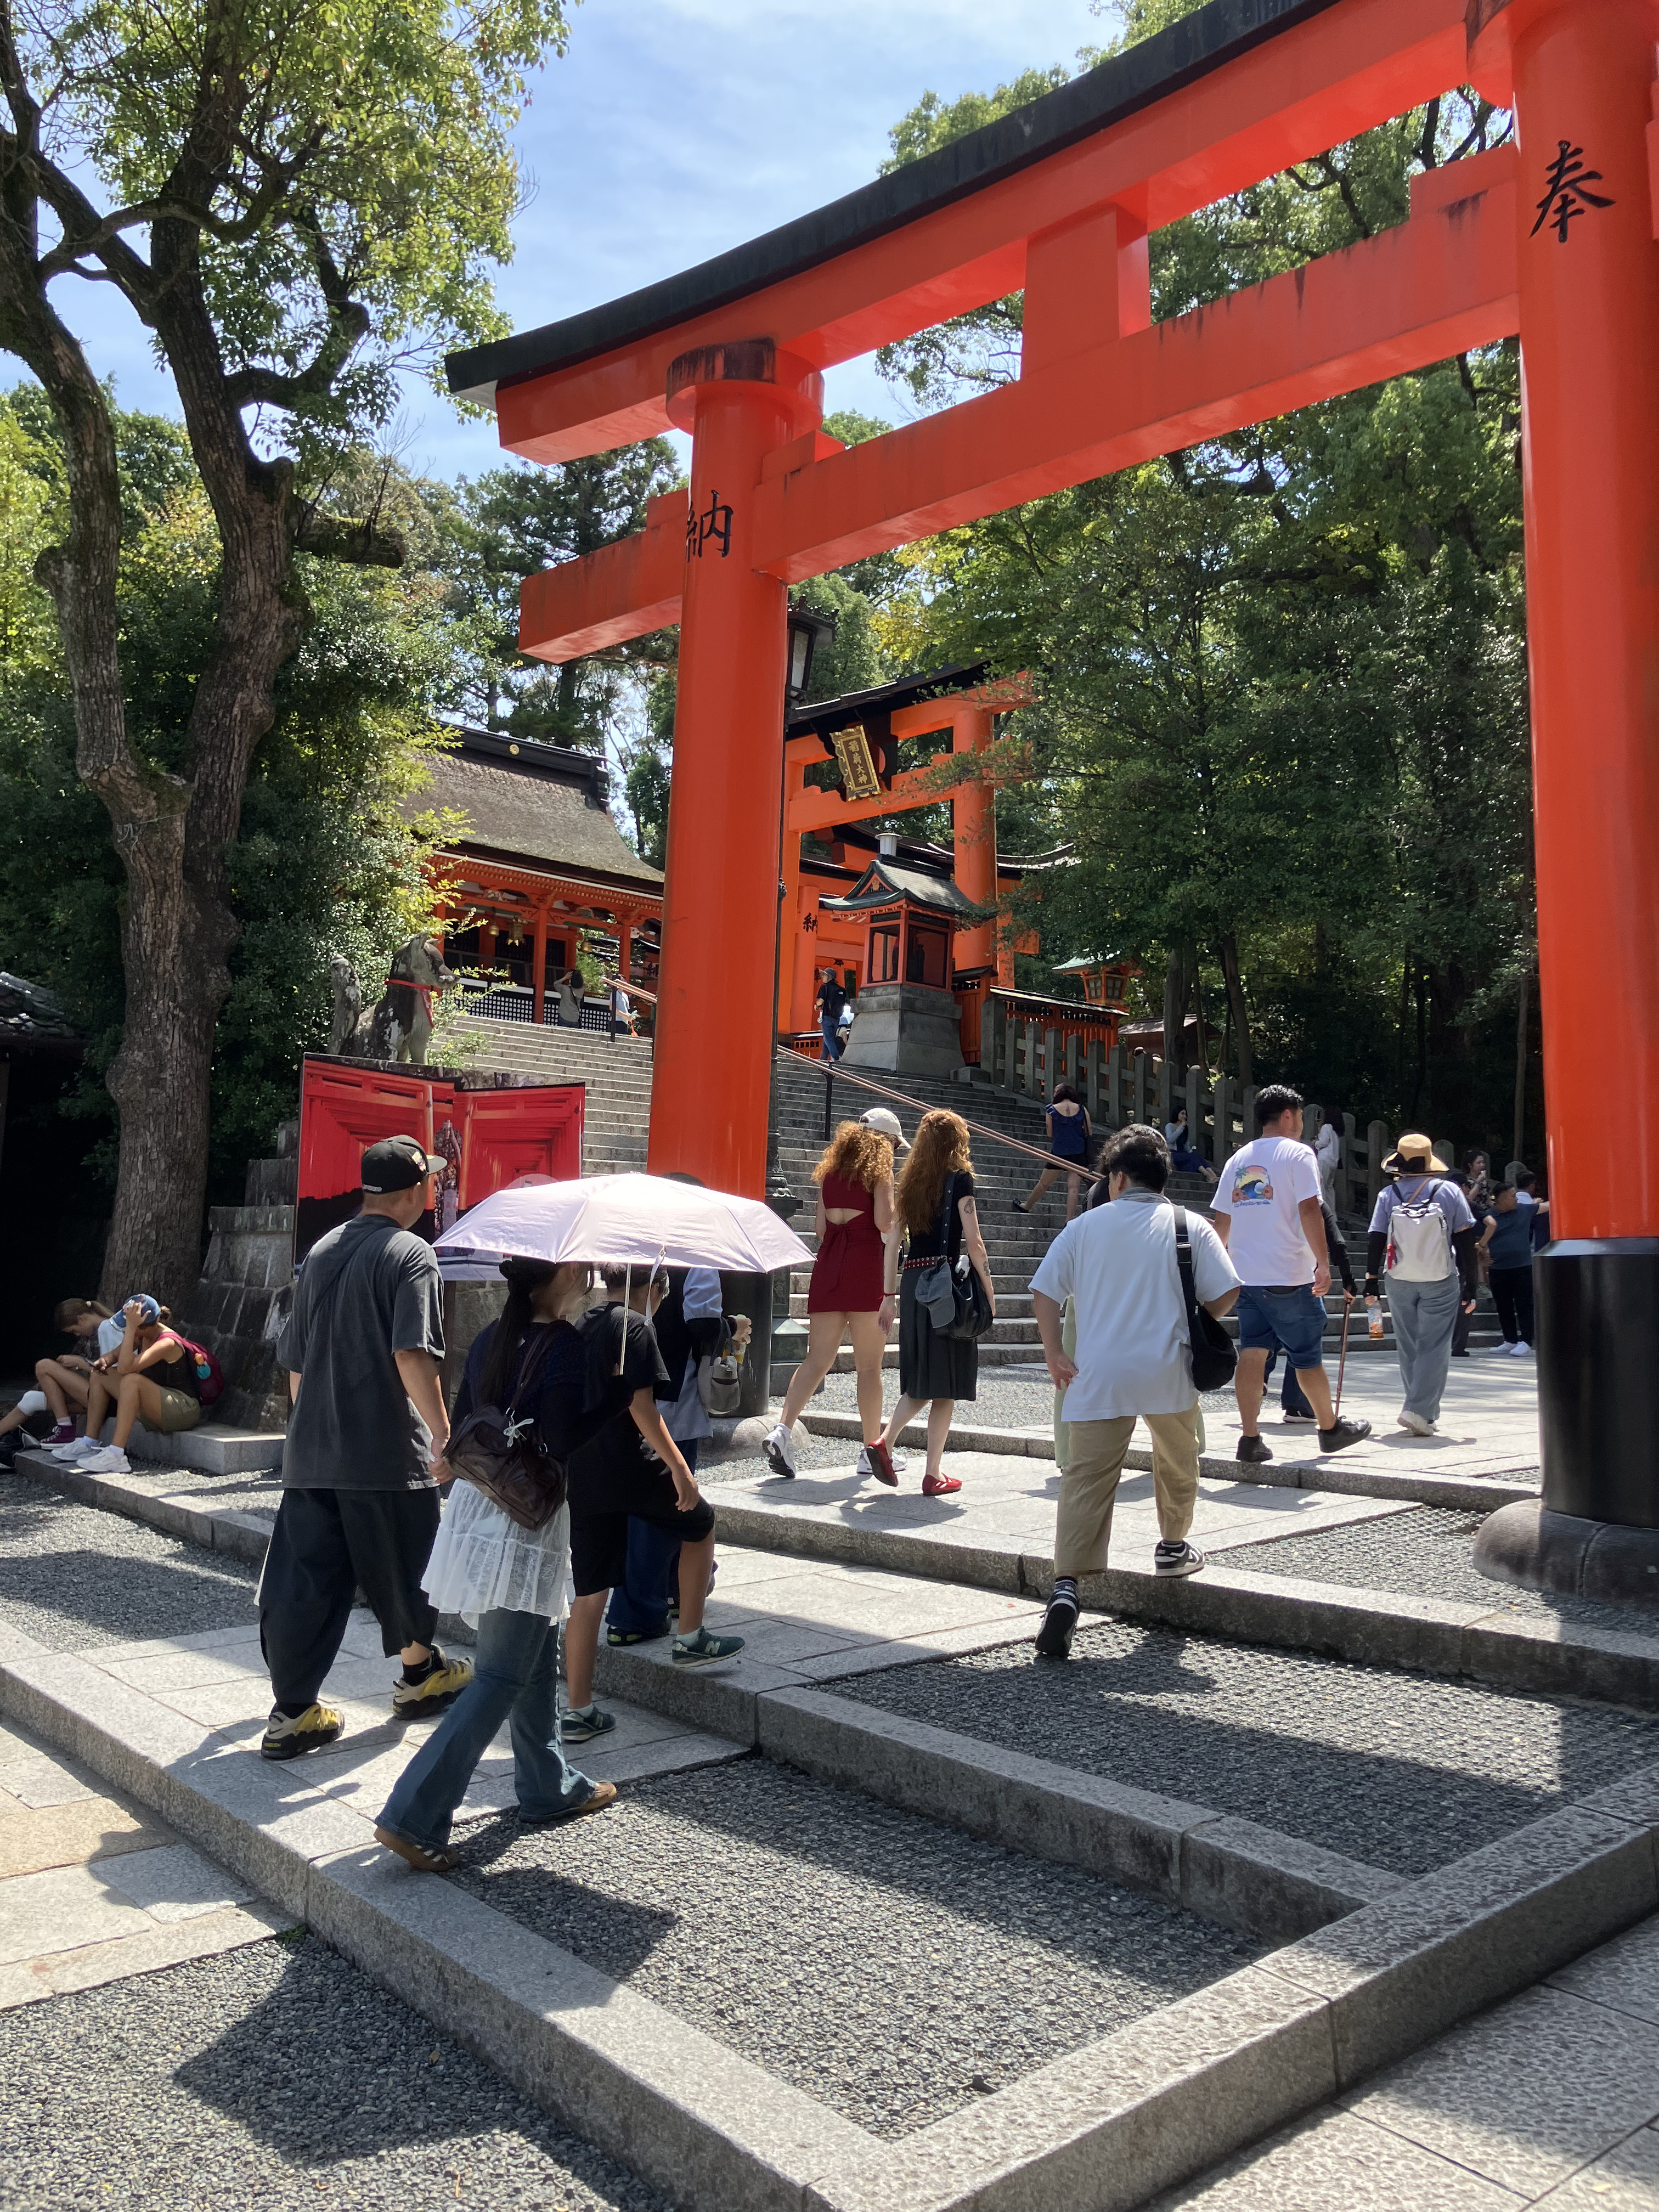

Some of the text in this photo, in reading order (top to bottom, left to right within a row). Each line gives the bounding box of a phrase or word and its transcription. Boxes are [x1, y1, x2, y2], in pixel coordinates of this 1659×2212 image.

[1528, 140, 1618, 243] 奉
[686, 489, 734, 563] 納
[803, 912, 818, 935] 納
